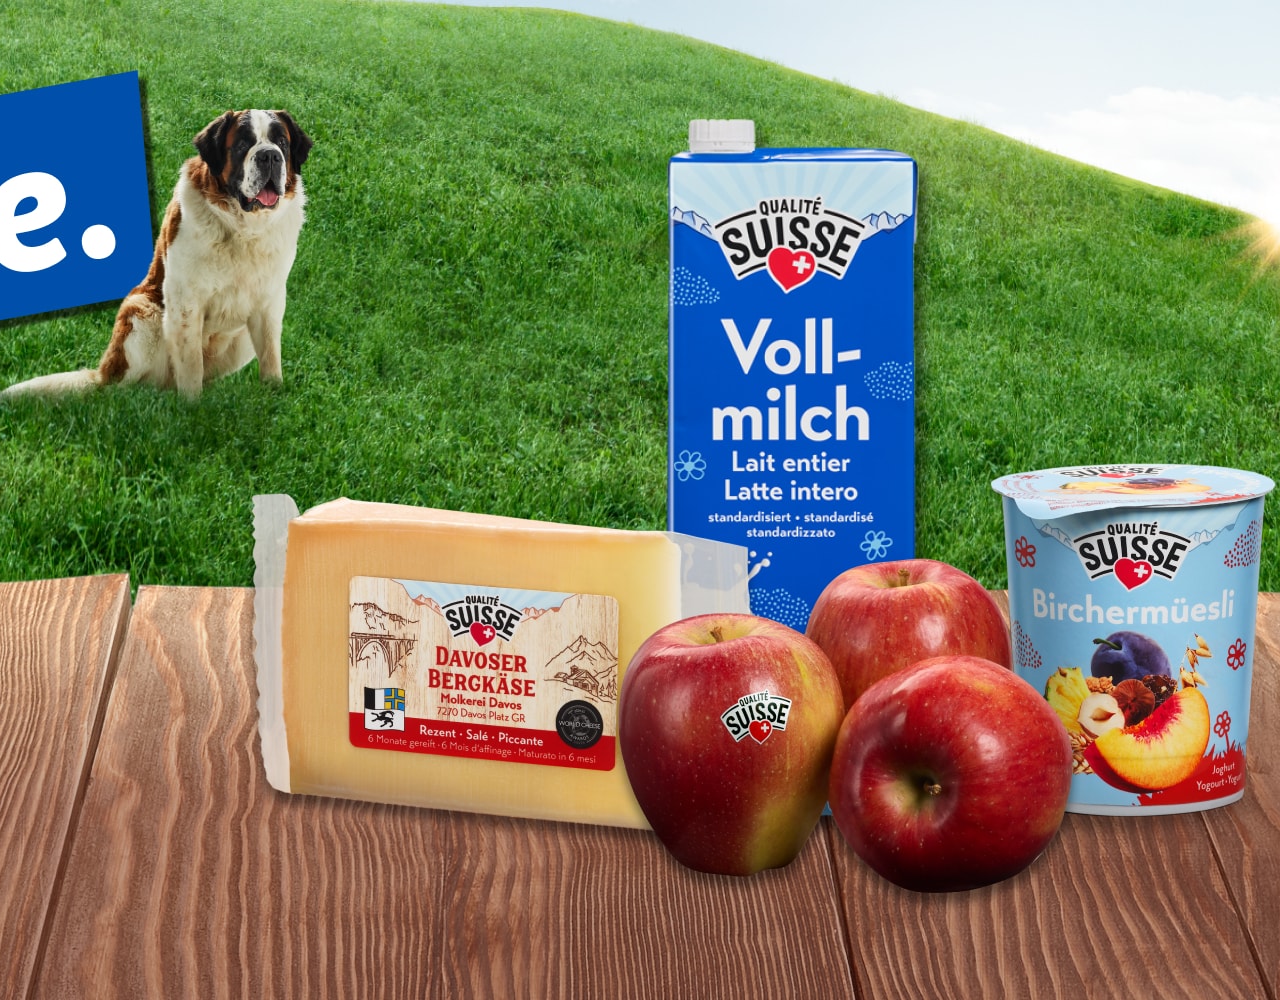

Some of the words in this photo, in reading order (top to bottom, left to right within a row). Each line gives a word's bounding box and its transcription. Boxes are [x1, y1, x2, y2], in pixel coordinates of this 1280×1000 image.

[759, 197, 822, 216] QUALITÉ
[722, 216, 861, 267] SUISSE
[721, 318, 860, 374] Voll-
[713, 385, 869, 441] milch
[732, 451, 775, 472] Lait
[783, 452, 850, 472] entier
[725, 479, 783, 500] Latte
[791, 480, 858, 501] intero
[708, 511, 791, 522] standardisiert
[804, 511, 874, 522] standardisé
[746, 527, 836, 538] standardizzato
[1107, 521, 1158, 536] QUALITÉ
[1079, 535, 1188, 573] SUISSE
[465, 595, 499, 606] QUALITÉ
[1033, 588, 1234, 625] Birchermüesli
[445, 605, 520, 636] SUISSE
[436, 646, 527, 673] DAVOSER
[428, 668, 535, 697] BERGKÄSE
[440, 692, 486, 707] Molkerei
[489, 697, 522, 710] Davos
[740, 690, 769, 706] QUALITÉ
[437, 706, 458, 717] 7270
[461, 708, 486, 719] Davos
[489, 711, 509, 722] Platz
[511, 713, 525, 723] GR
[726, 702, 789, 735] SUISSE
[420, 724, 456, 738] Rezent
[466, 729, 488, 741] Salé
[498, 732, 543, 746] Piccante
[367, 734, 374, 743] 6
[376, 735, 407, 746] Monate
[409, 739, 435, 749] gereift
[441, 741, 448, 749] 6
[450, 742, 469, 751] Mois
[518, 748, 556, 760] Maturato
[558, 752, 567, 760] in
[568, 753, 575, 761] 6
[576, 755, 596, 763] mesi
[1212, 761, 1235, 776] Joghurt
[1196, 779, 1225, 792] Yogourt
